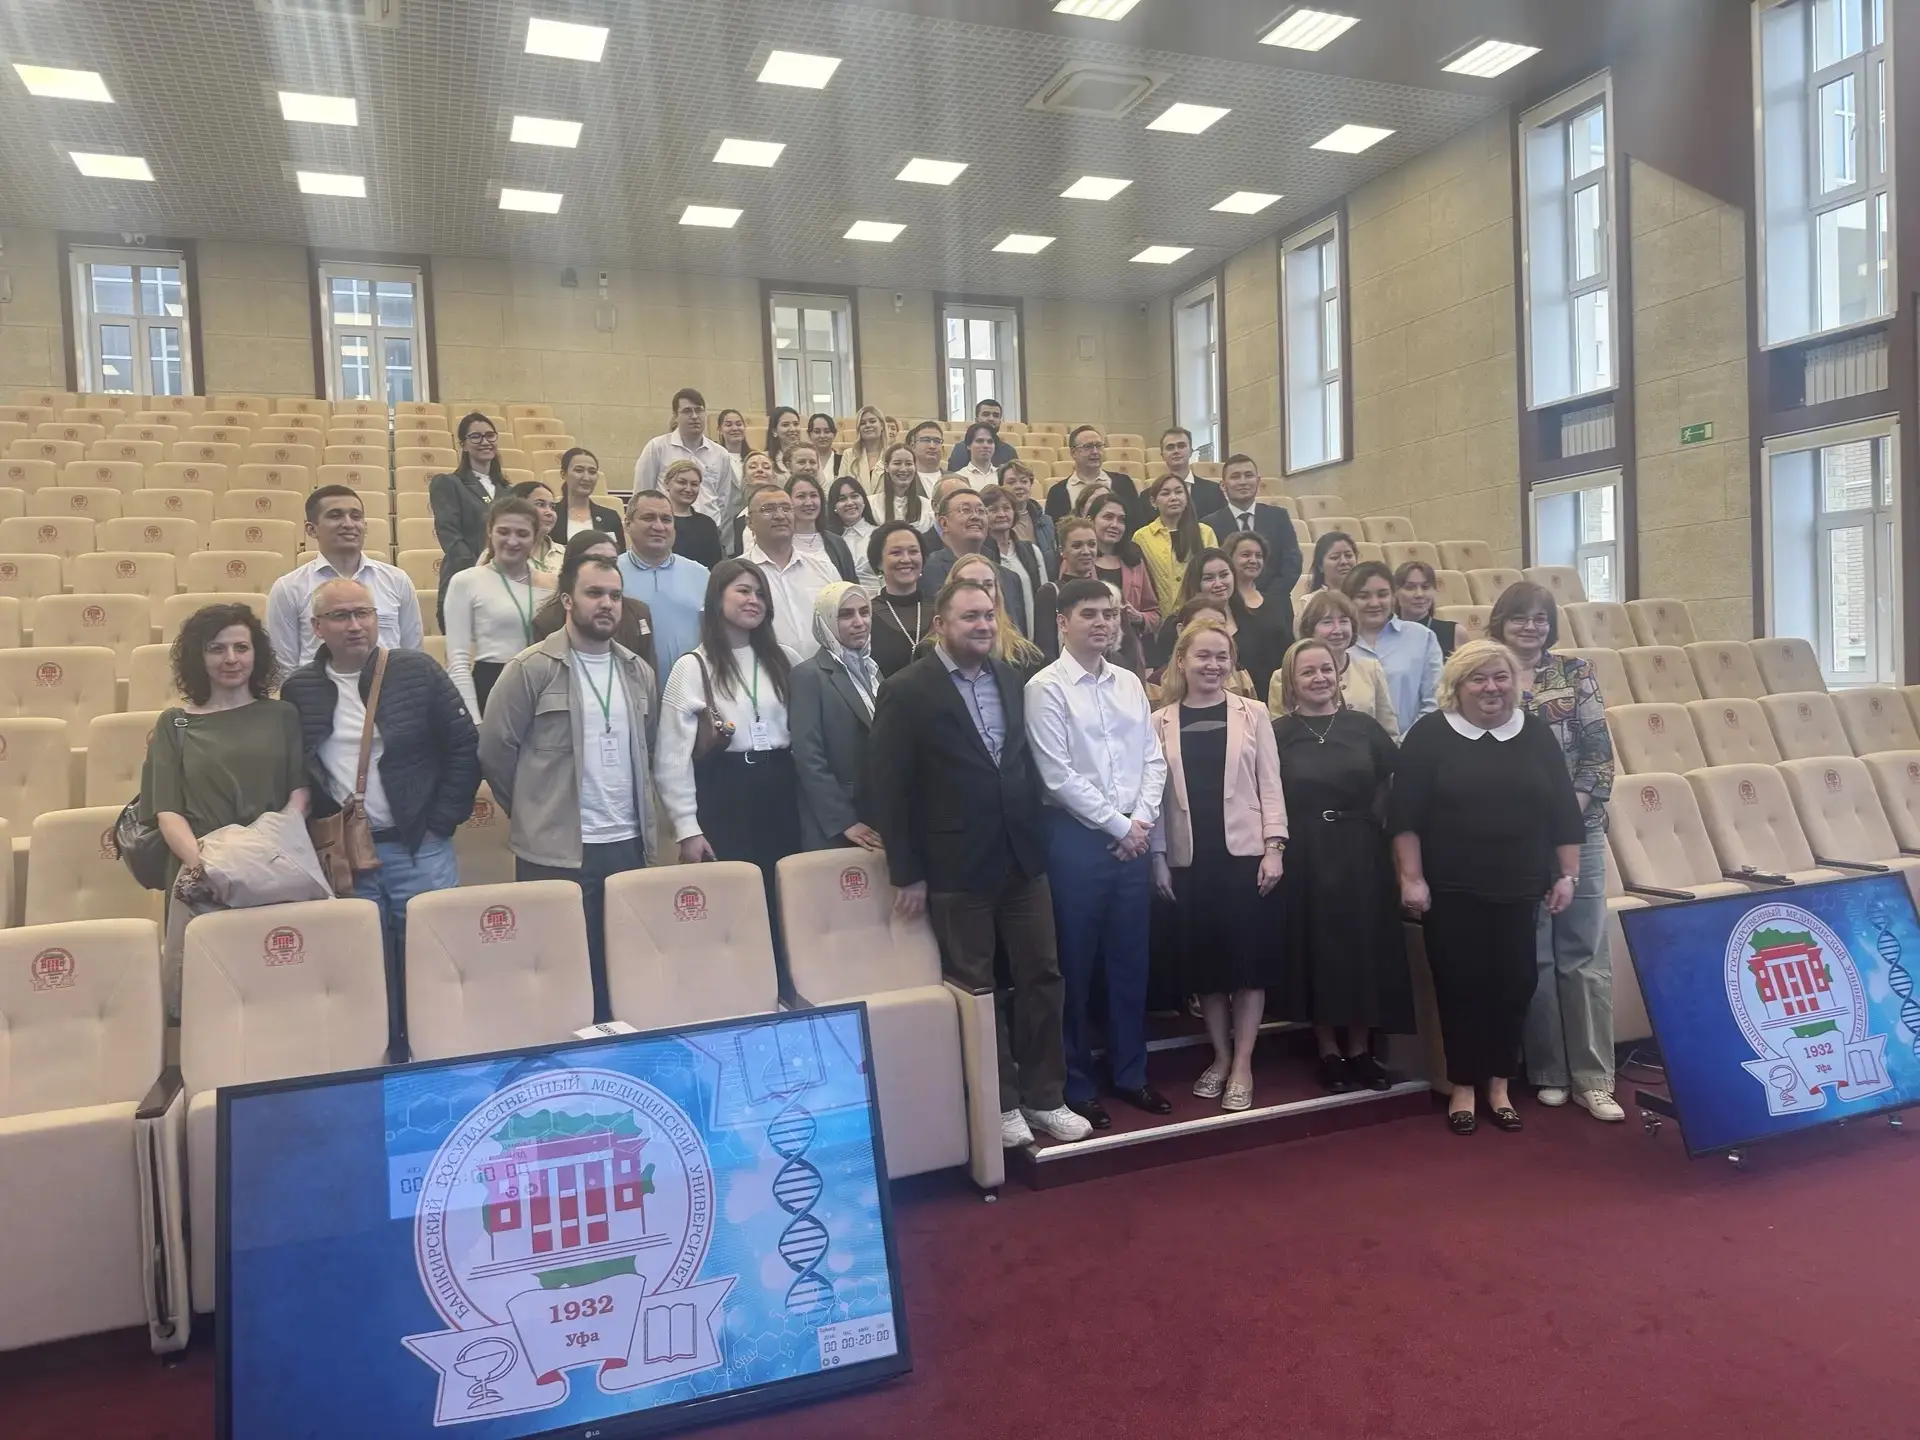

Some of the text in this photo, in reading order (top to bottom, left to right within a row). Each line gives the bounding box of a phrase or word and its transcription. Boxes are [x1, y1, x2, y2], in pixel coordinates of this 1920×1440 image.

[1729, 907, 1865, 1053] БАШКИРСКИЙ ГОСУДАРСТВЕННЫЙ МЕДИЦИНСКИЙ УНИВЕРСИТЕТ
[1803, 1042, 1834, 1060] 1932
[1815, 1063, 1833, 1074] Уфа
[425, 1074, 706, 1319] БАШКИРСКИЙ ГОСУДАРСТВЕННЫЙ МЕДИЦИНСКИЙ УНИВЕРСИТЕТ
[549, 1294, 614, 1325] 1932
[565, 1330, 600, 1348] Уфа
[824, 1340, 837, 1353] 00
